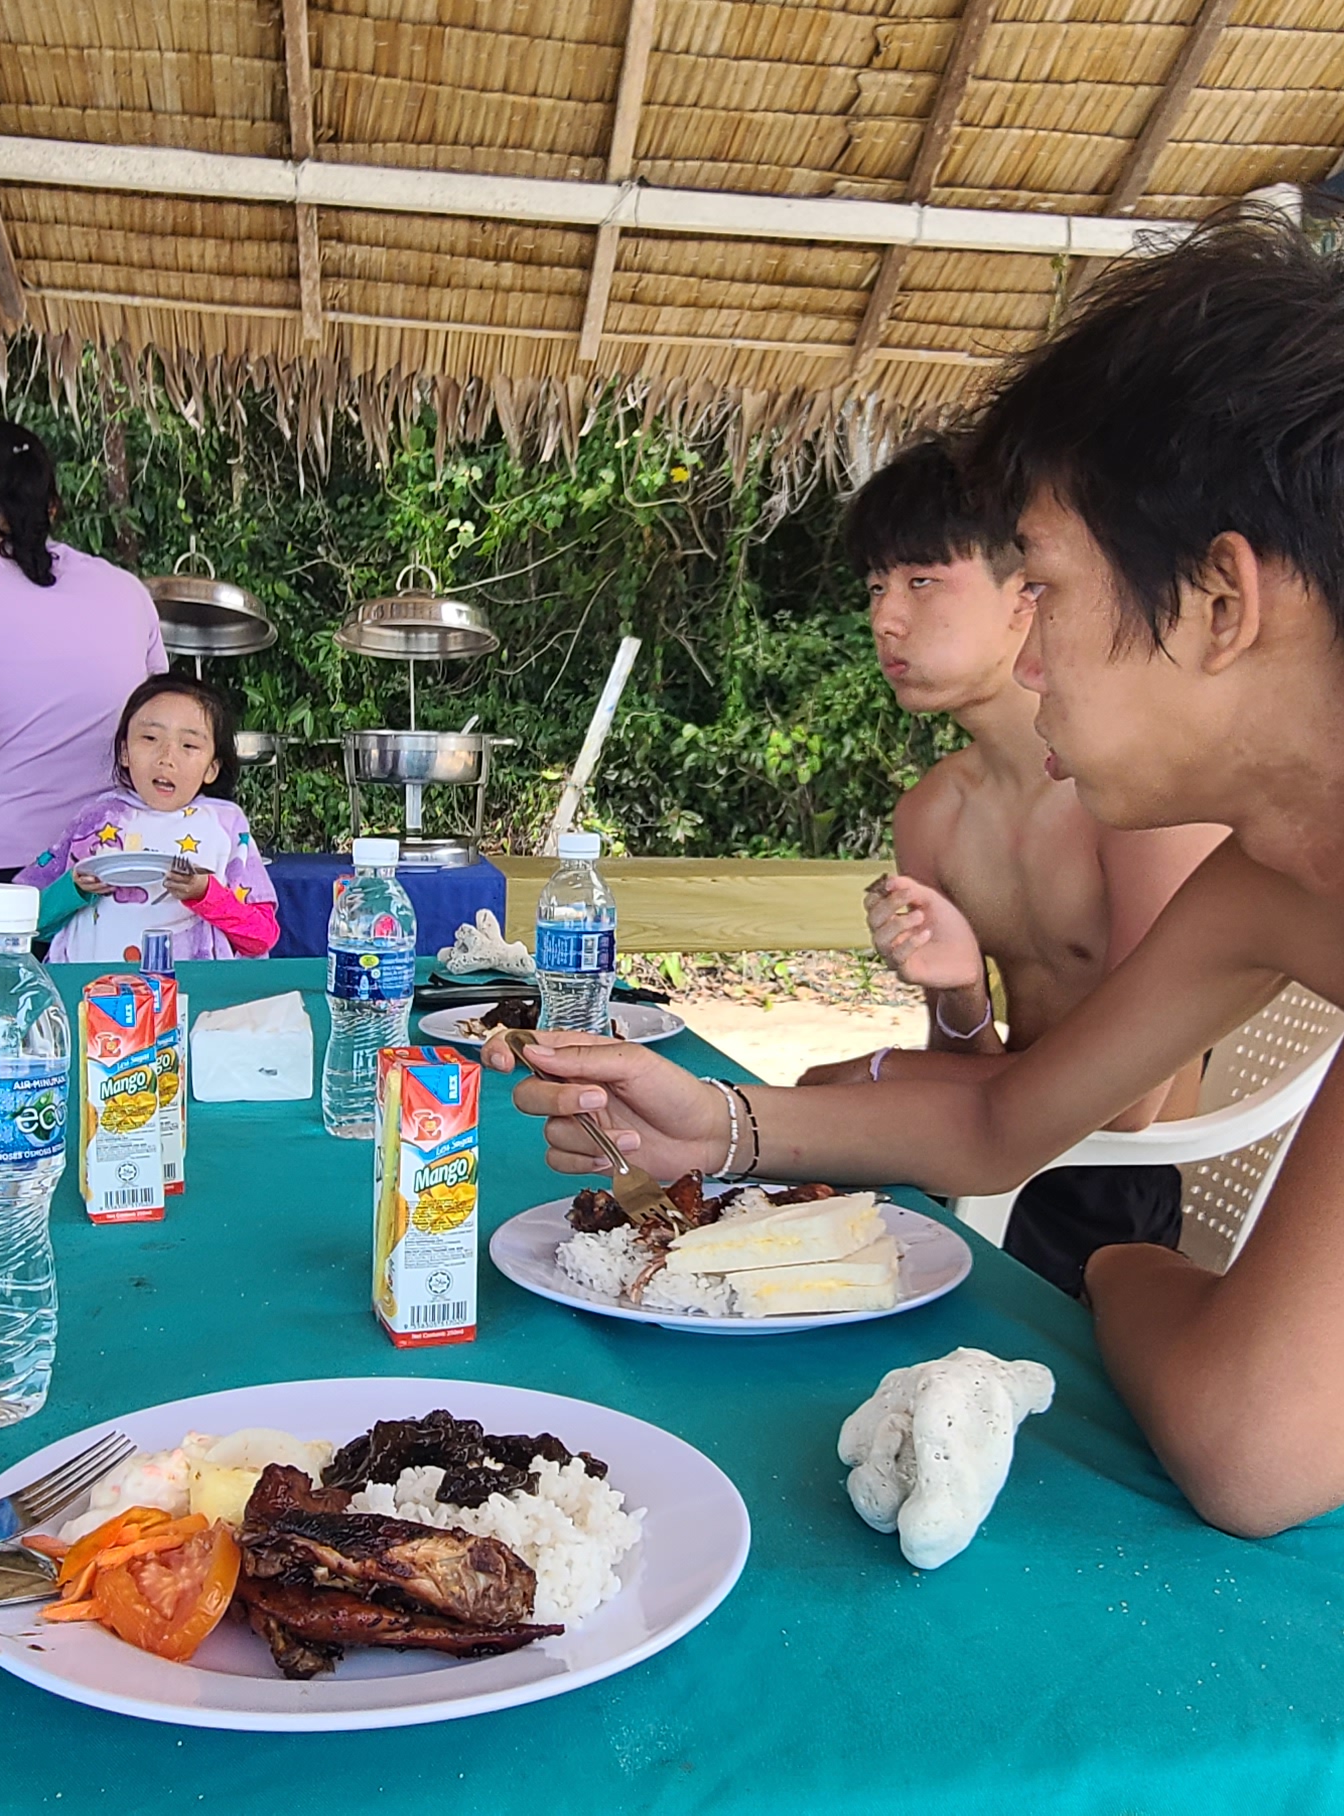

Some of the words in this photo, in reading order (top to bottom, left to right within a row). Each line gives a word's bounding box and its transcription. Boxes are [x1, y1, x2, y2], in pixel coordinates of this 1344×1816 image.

[101, 1071, 146, 1099] Mango
[15, 1100, 68, 1134] eco
[414, 1157, 468, 1193] Mango
